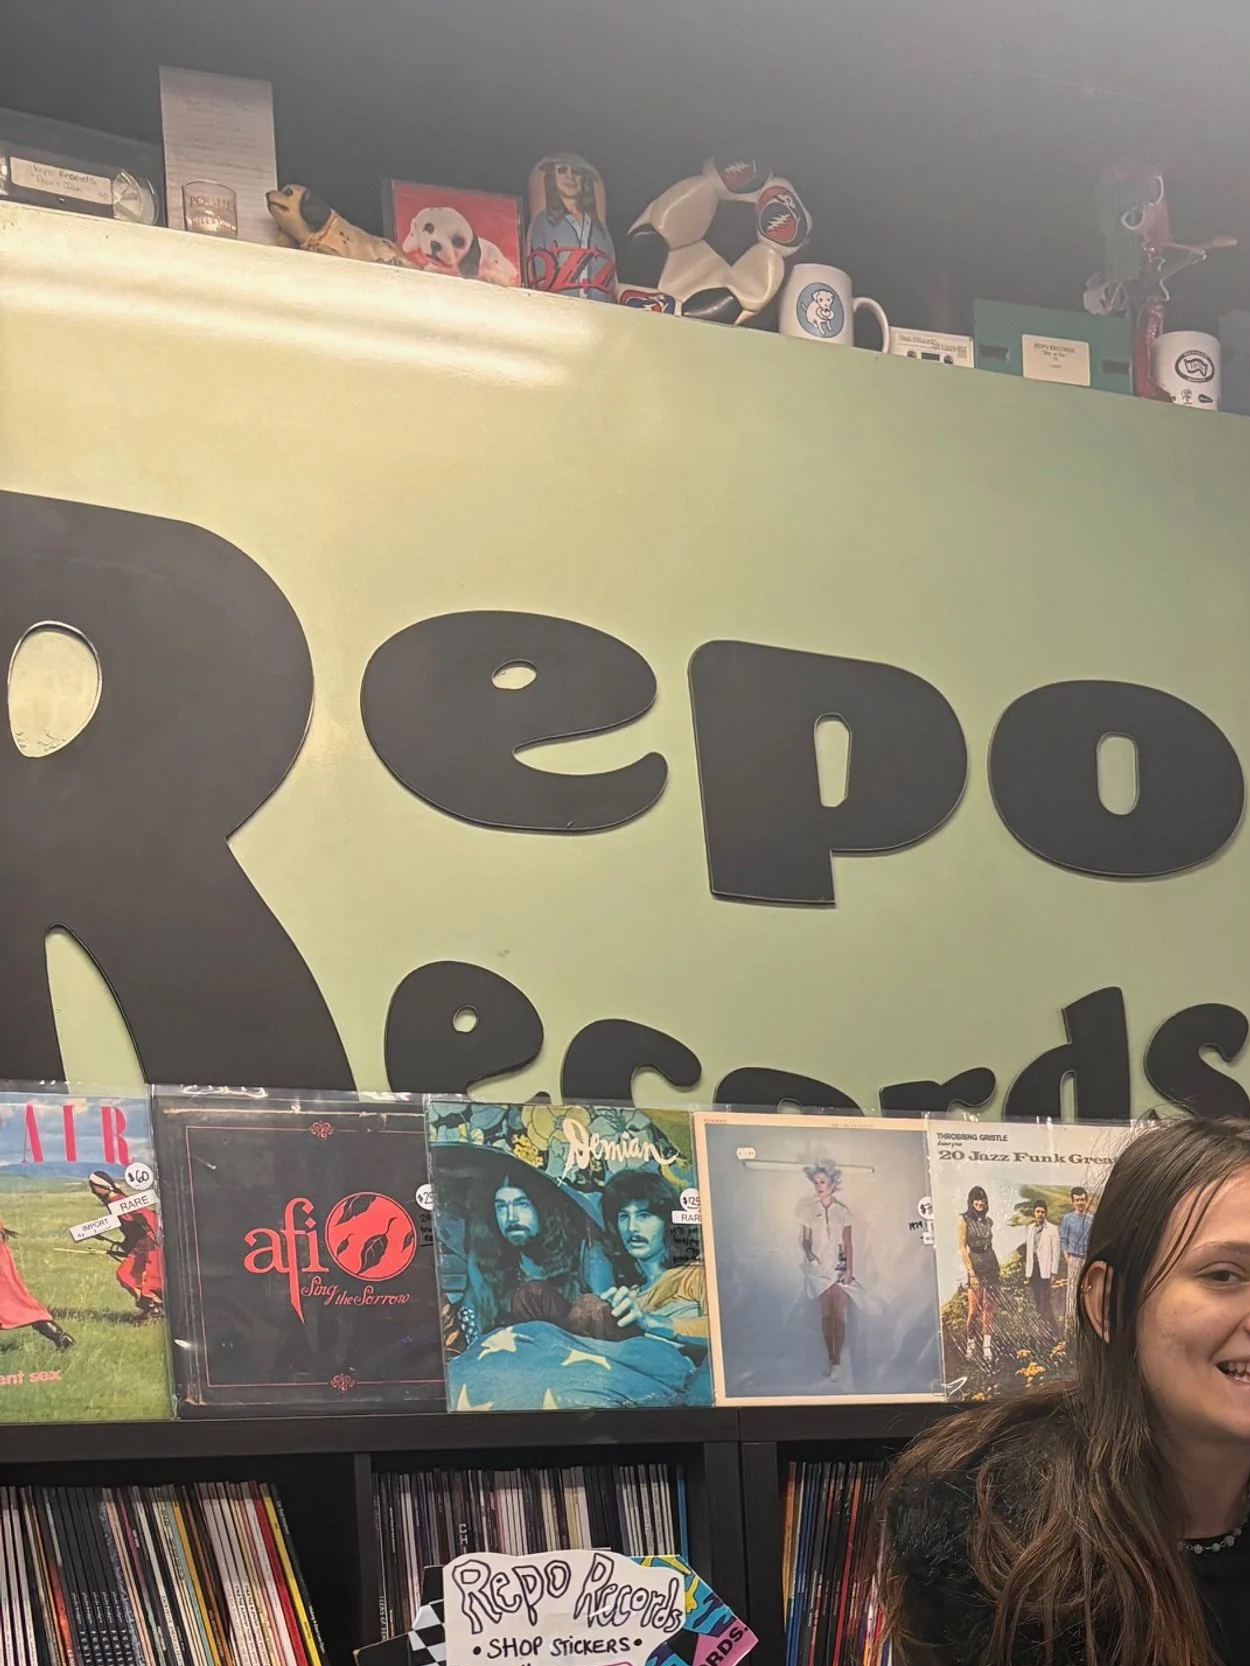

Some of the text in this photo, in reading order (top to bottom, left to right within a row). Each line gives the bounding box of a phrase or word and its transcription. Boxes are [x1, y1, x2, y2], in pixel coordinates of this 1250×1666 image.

[936, 1132, 1008, 1142] THROBBING GRISTLE
[557, 1118, 682, 1187] Demian
[938, 1149, 1066, 1164] 20 Jazz Funk
[128, 1169, 149, 1183] $60
[119, 1195, 150, 1212] RARE
[81, 1218, 109, 1231] IMPORT
[681, 1212, 701, 1223] RAR
[243, 1197, 329, 1324] afi
[301, 1275, 410, 1306] Sing the Sorrow
[29, 1370, 61, 1384] sex
[451, 1552, 685, 1635] Repo Records
[486, 1636, 543, 1659] SHOP
